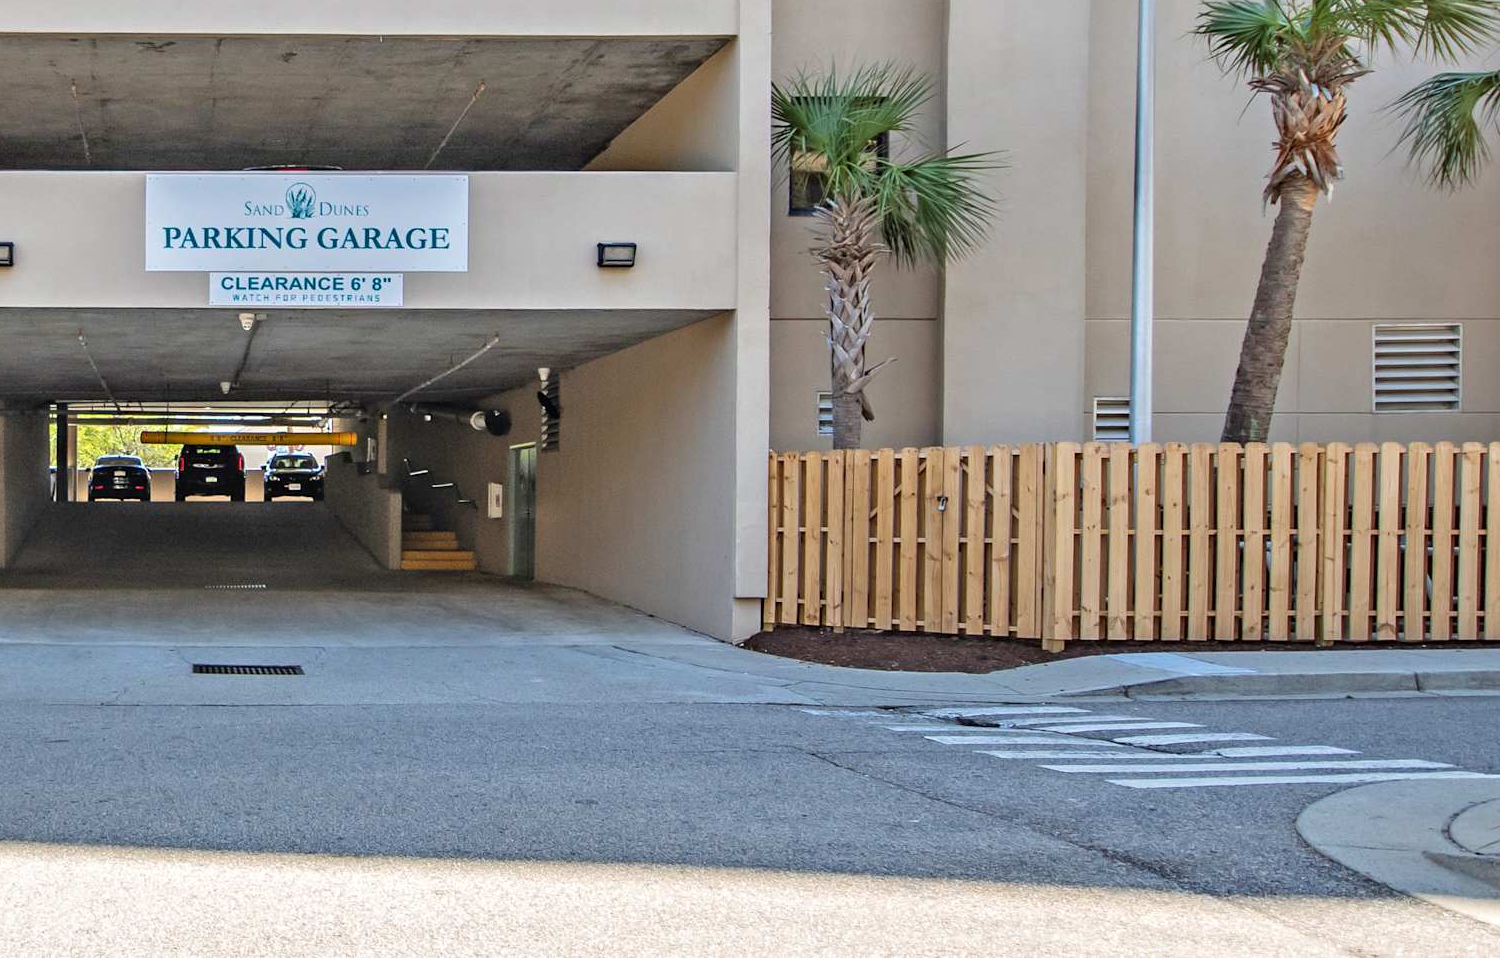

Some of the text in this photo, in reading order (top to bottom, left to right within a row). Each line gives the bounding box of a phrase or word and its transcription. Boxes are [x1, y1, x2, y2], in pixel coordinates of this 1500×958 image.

[244, 201, 370, 216] SAND DUNES
[163, 226, 450, 250] PARKING GARAGE
[221, 276, 392, 291] CLEARANCE 6' 8"
[232, 293, 381, 303] WATCH FOR PEDESTRIANS
